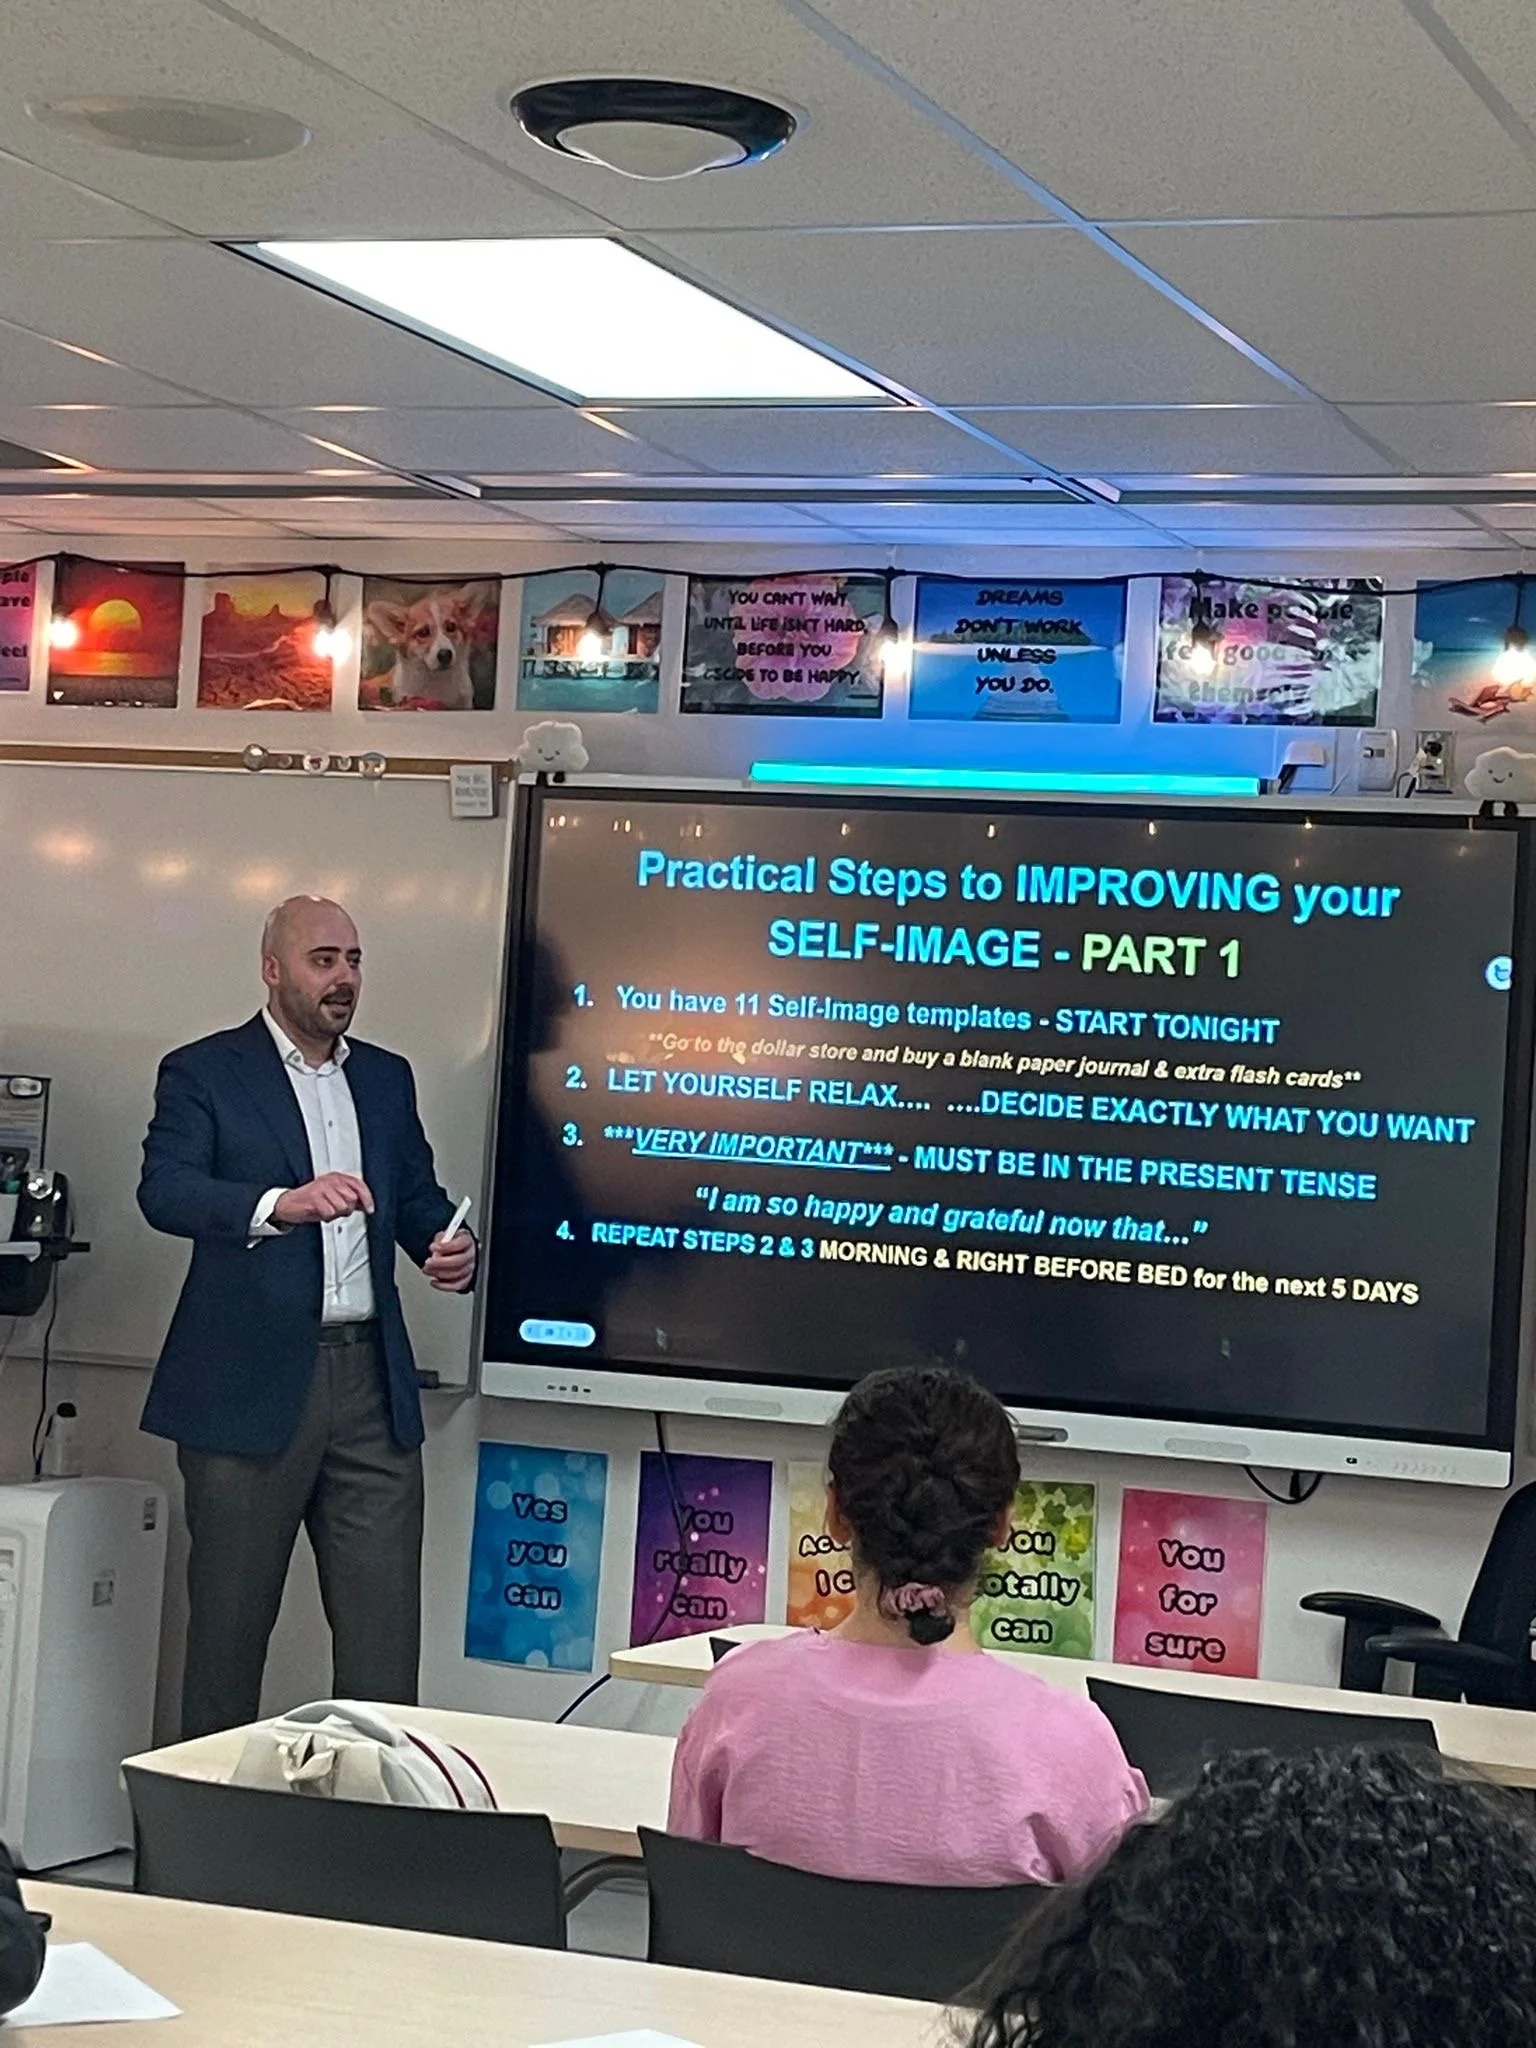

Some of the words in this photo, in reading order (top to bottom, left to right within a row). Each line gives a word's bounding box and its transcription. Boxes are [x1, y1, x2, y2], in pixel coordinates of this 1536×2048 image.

[729, 591, 758, 605] YOU
[763, 591, 805, 606] CAN'T
[975, 588, 1064, 606] DREAMS
[954, 617, 1020, 634] DON'T
[1023, 618, 1083, 634] WORK
[737, 643, 794, 656] BEFORE
[800, 644, 832, 657] YOU
[976, 648, 1057, 664] UNLESS
[760, 669, 779, 682] TO
[783, 669, 803, 682] BE
[975, 675, 1017, 695] YOU
[1019, 676, 1055, 694] DO.
[639, 851, 815, 893] Practical
[829, 858, 947, 906] Steps
[961, 864, 1002, 901] to
[1017, 864, 1280, 912] IMPROVING
[1293, 884, 1401, 924] your
[769, 920, 1041, 968] SELF-IMAGE
[1082, 934, 1207, 976] PART
[1220, 940, 1239, 977] 1
[575, 985, 593, 1006] 1.
[617, 986, 660, 1009] You
[671, 990, 726, 1012] have
[736, 994, 757, 1014] 11
[769, 994, 899, 1027] Self-Image
[907, 1002, 1031, 1032] templates
[1055, 1009, 1147, 1036] START
[1152, 1013, 1280, 1044] TONIGHT
[695, 1038, 711, 1051] to
[717, 1037, 746, 1056] the
[752, 1039, 805, 1057] dollar
[809, 1044, 857, 1060] store
[862, 1046, 899, 1062] and
[903, 1047, 940, 1069] buy
[943, 1053, 955, 1066] a
[959, 1050, 1013, 1069] blank
[1016, 1057, 1076, 1075] paper
[1075, 1056, 1150, 1077] journal
[1154, 1060, 1168, 1078] &
[1174, 1064, 1225, 1081] extra
[1230, 1065, 1280, 1084] flash
[566, 1066, 587, 1088] 2.
[609, 1069, 656, 1092] LET
[664, 1072, 802, 1101] YOURSELF
[1091, 1097, 1219, 1127] EXACTLY
[1225, 1103, 1310, 1133] WHAT
[1316, 1109, 1379, 1138] YOU
[1386, 1113, 1475, 1143] WANT
[563, 1123, 583, 1146] 3.
[914, 1145, 992, 1173] MUST
[997, 1150, 1036, 1176] BE
[1042, 1153, 1071, 1179] IN
[1077, 1155, 1133, 1183] THE
[1140, 1160, 1274, 1192] PRESENT
[1280, 1169, 1376, 1199] TENSE
[722, 1194, 761, 1213] am
[766, 1197, 798, 1216] so
[804, 1194, 884, 1227] happy
[888, 1203, 939, 1227] and
[942, 1208, 1045, 1234] grateful
[1049, 1215, 1107, 1238] now
[556, 1220, 575, 1240] 4.
[592, 1222, 680, 1248] REPEAT
[682, 1228, 755, 1255] STEPS
[760, 1236, 774, 1255] 2
[778, 1236, 795, 1257] &
[801, 1238, 815, 1258] 3
[820, 1240, 927, 1266] MORNING
[933, 1249, 950, 1268] &
[957, 1250, 1029, 1274] RIGHT
[1034, 1256, 1131, 1282] BEFORE
[1138, 1263, 1187, 1286] BED
[1194, 1268, 1227, 1289] for
[1232, 1271, 1268, 1293] the
[1275, 1278, 1326, 1297] next
[1332, 1278, 1346, 1299] 5
[1353, 1279, 1419, 1304] DAYS
[512, 1493, 568, 1523] Yes
[507, 1539, 567, 1567] you
[998, 1526, 1055, 1555] ou
[1159, 1538, 1225, 1572] You
[504, 1582, 562, 1610] can
[978, 1570, 1080, 1606] otally
[1159, 1583, 1217, 1616] for
[670, 1593, 727, 1620] can
[991, 1617, 1053, 1643] can
[1145, 1632, 1225, 1662] sure
